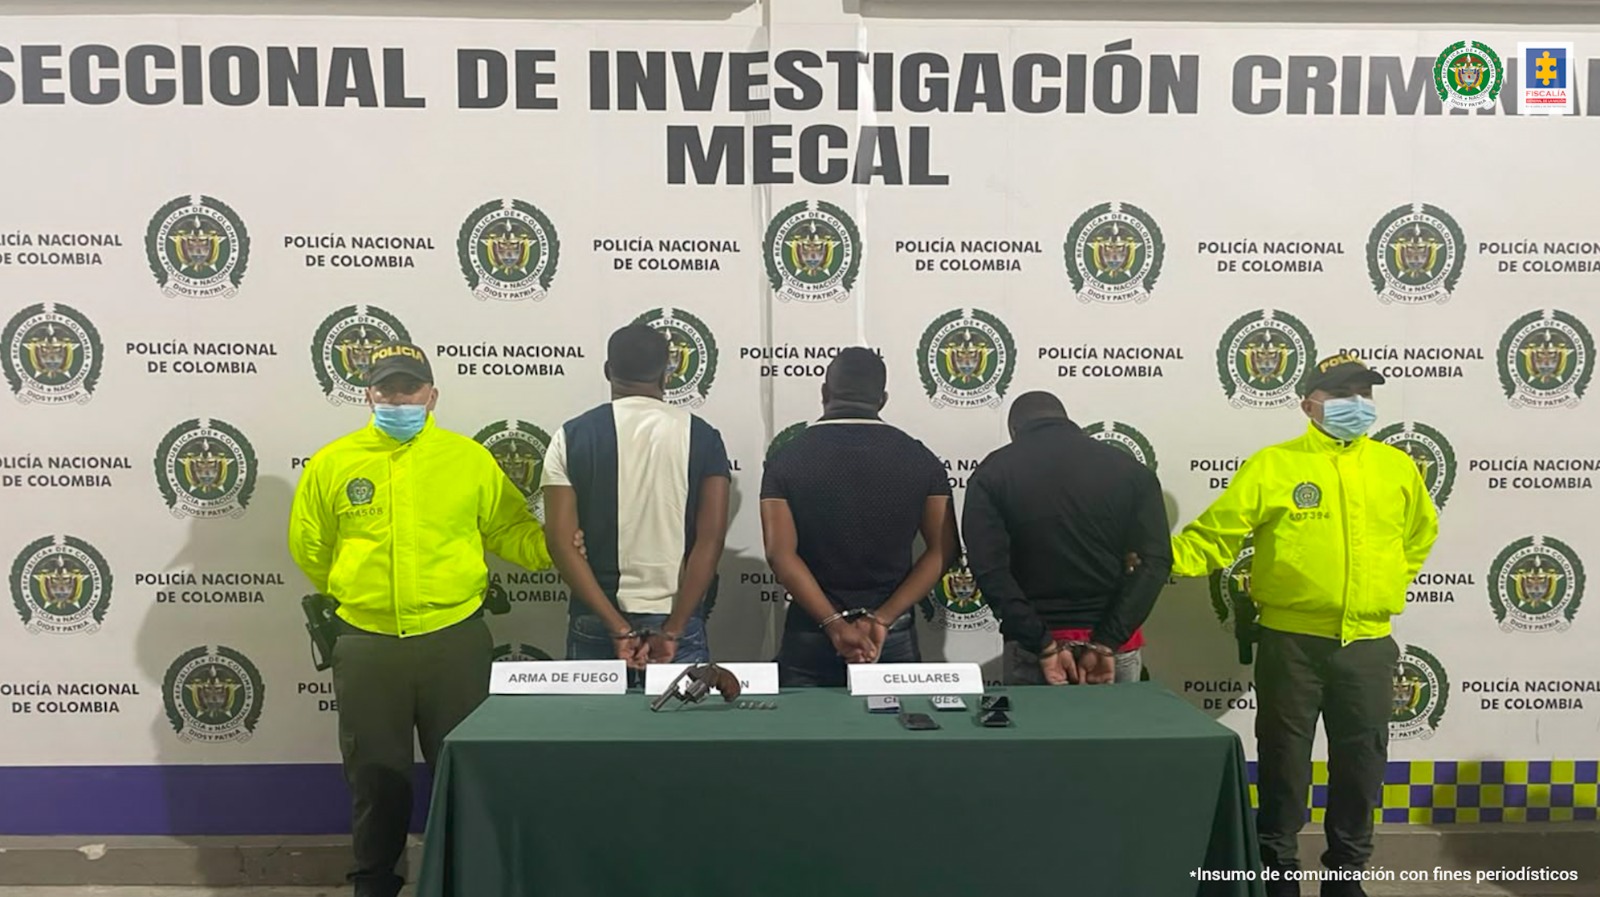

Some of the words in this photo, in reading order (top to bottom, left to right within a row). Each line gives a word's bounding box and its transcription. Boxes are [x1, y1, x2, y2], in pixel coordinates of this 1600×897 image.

[457, 49, 558, 110] DE
[589, 38, 1199, 115] INVESTIGACIÓN
[667, 124, 949, 185] MECAL
[0, 231, 33, 246] ICÍA
[38, 234, 122, 246] NACIONAL
[284, 233, 346, 248] POLICÍA
[352, 237, 435, 249] NACIONAL
[826, 216, 851, 258] COLOMBIA
[1430, 219, 1455, 260] COLOMBIA
[594, 237, 654, 252] POLICÍA
[659, 240, 740, 252] NACIONAL
[896, 238, 955, 253] POLICÍA
[961, 241, 1042, 253] NACIONAL
[1198, 239, 1258, 254] POLICÍA
[1263, 242, 1344, 254] NACIONAL
[1479, 239, 1538, 254] POLICÍA
[1544, 242, 1600, 254] NACION
[0, 253, 12, 264] E
[17, 252, 102, 265] COLOMBIA
[306, 255, 325, 267] DE
[331, 255, 414, 268] COLOMBIA
[614, 258, 632, 270] DE
[638, 258, 720, 270] COLOMBIA
[916, 259, 934, 271] DE
[940, 259, 1021, 271] COLOMBIA
[1218, 260, 1236, 272] DE
[1242, 260, 1323, 272] COLOMBIA
[1498, 261, 1517, 272] DE
[1522, 260, 1600, 272] COLOMBIA
[814, 266, 846, 290] NACIONAL
[813, 289, 838, 300] PATRIA
[126, 340, 188, 355] POLICÍA
[194, 343, 277, 355] NACIONAL
[437, 342, 498, 357] POLICÍA
[503, 346, 584, 358] NACIONAL
[740, 343, 799, 359] POLICÍA
[980, 324, 1005, 364] COLOMBIA
[1560, 325, 1585, 365] COLOMBIA
[1039, 344, 1098, 359] POLICÍA
[1103, 348, 1183, 359] NACIONAL
[1339, 345, 1398, 360] POLICÍA
[1404, 348, 1484, 360] NACIONAL
[148, 361, 167, 373] DE
[173, 361, 257, 374] COLOMBIA
[458, 363, 477, 375] DE
[482, 363, 564, 376] COLOMBIA
[760, 365, 778, 377] DE
[784, 365, 825, 377] COLO
[1058, 365, 1076, 377] DE
[1082, 365, 1163, 377] COLOMBIA
[1382, 366, 1463, 378] COLOMBIA
[967, 373, 1000, 396] NACIONAL
[1546, 373, 1579, 396] NACIONAL
[966, 395, 992, 406] PATRIA
[1545, 395, 1570, 406] PATRIA
[0, 453, 43, 469] LICÍA
[48, 457, 132, 469] NACIONAL
[220, 434, 245, 475] COLOMBIA
[1469, 457, 1528, 471] POLICÍA
[1534, 459, 1600, 471] NACIONA
[3, 475, 22, 487] DE
[28, 475, 112, 487] COLOMBIA
[1210, 478, 1228, 489] DE
[1489, 477, 1507, 489] DE
[1512, 477, 1592, 489] COLOMBIA
[208, 483, 242, 506] NACIONAL
[208, 505, 234, 516] PATRIA
[136, 570, 197, 585] POLICÍA
[202, 573, 285, 585] NACIONAL
[1550, 551, 1574, 590] COLOMBIA
[507, 573, 563, 584] NACIO
[157, 591, 176, 603] DE
[181, 591, 264, 603] COLOMBIA
[509, 590, 568, 602] LOMBIA
[760, 591, 779, 603] DE
[1536, 598, 1569, 620] NACIONAL
[1535, 619, 1560, 630] PATRIA
[508, 673, 547, 683] ARMA
[551, 673, 568, 683] DE
[573, 672, 619, 683] FUEGO
[883, 673, 960, 683] CELULARES
[1184, 677, 1242, 692] POLICÍA
[0, 680, 52, 695] OLICÍA
[57, 683, 139, 695] NACIONAL
[298, 683, 332, 694] POLI
[1462, 678, 1520, 692] POLICÍA
[12, 702, 31, 713] DE
[37, 701, 119, 713] COLOMBIA
[1204, 699, 1222, 710] DE
[1481, 699, 1499, 710] DE
[1504, 698, 1583, 710] COLOMBIA
